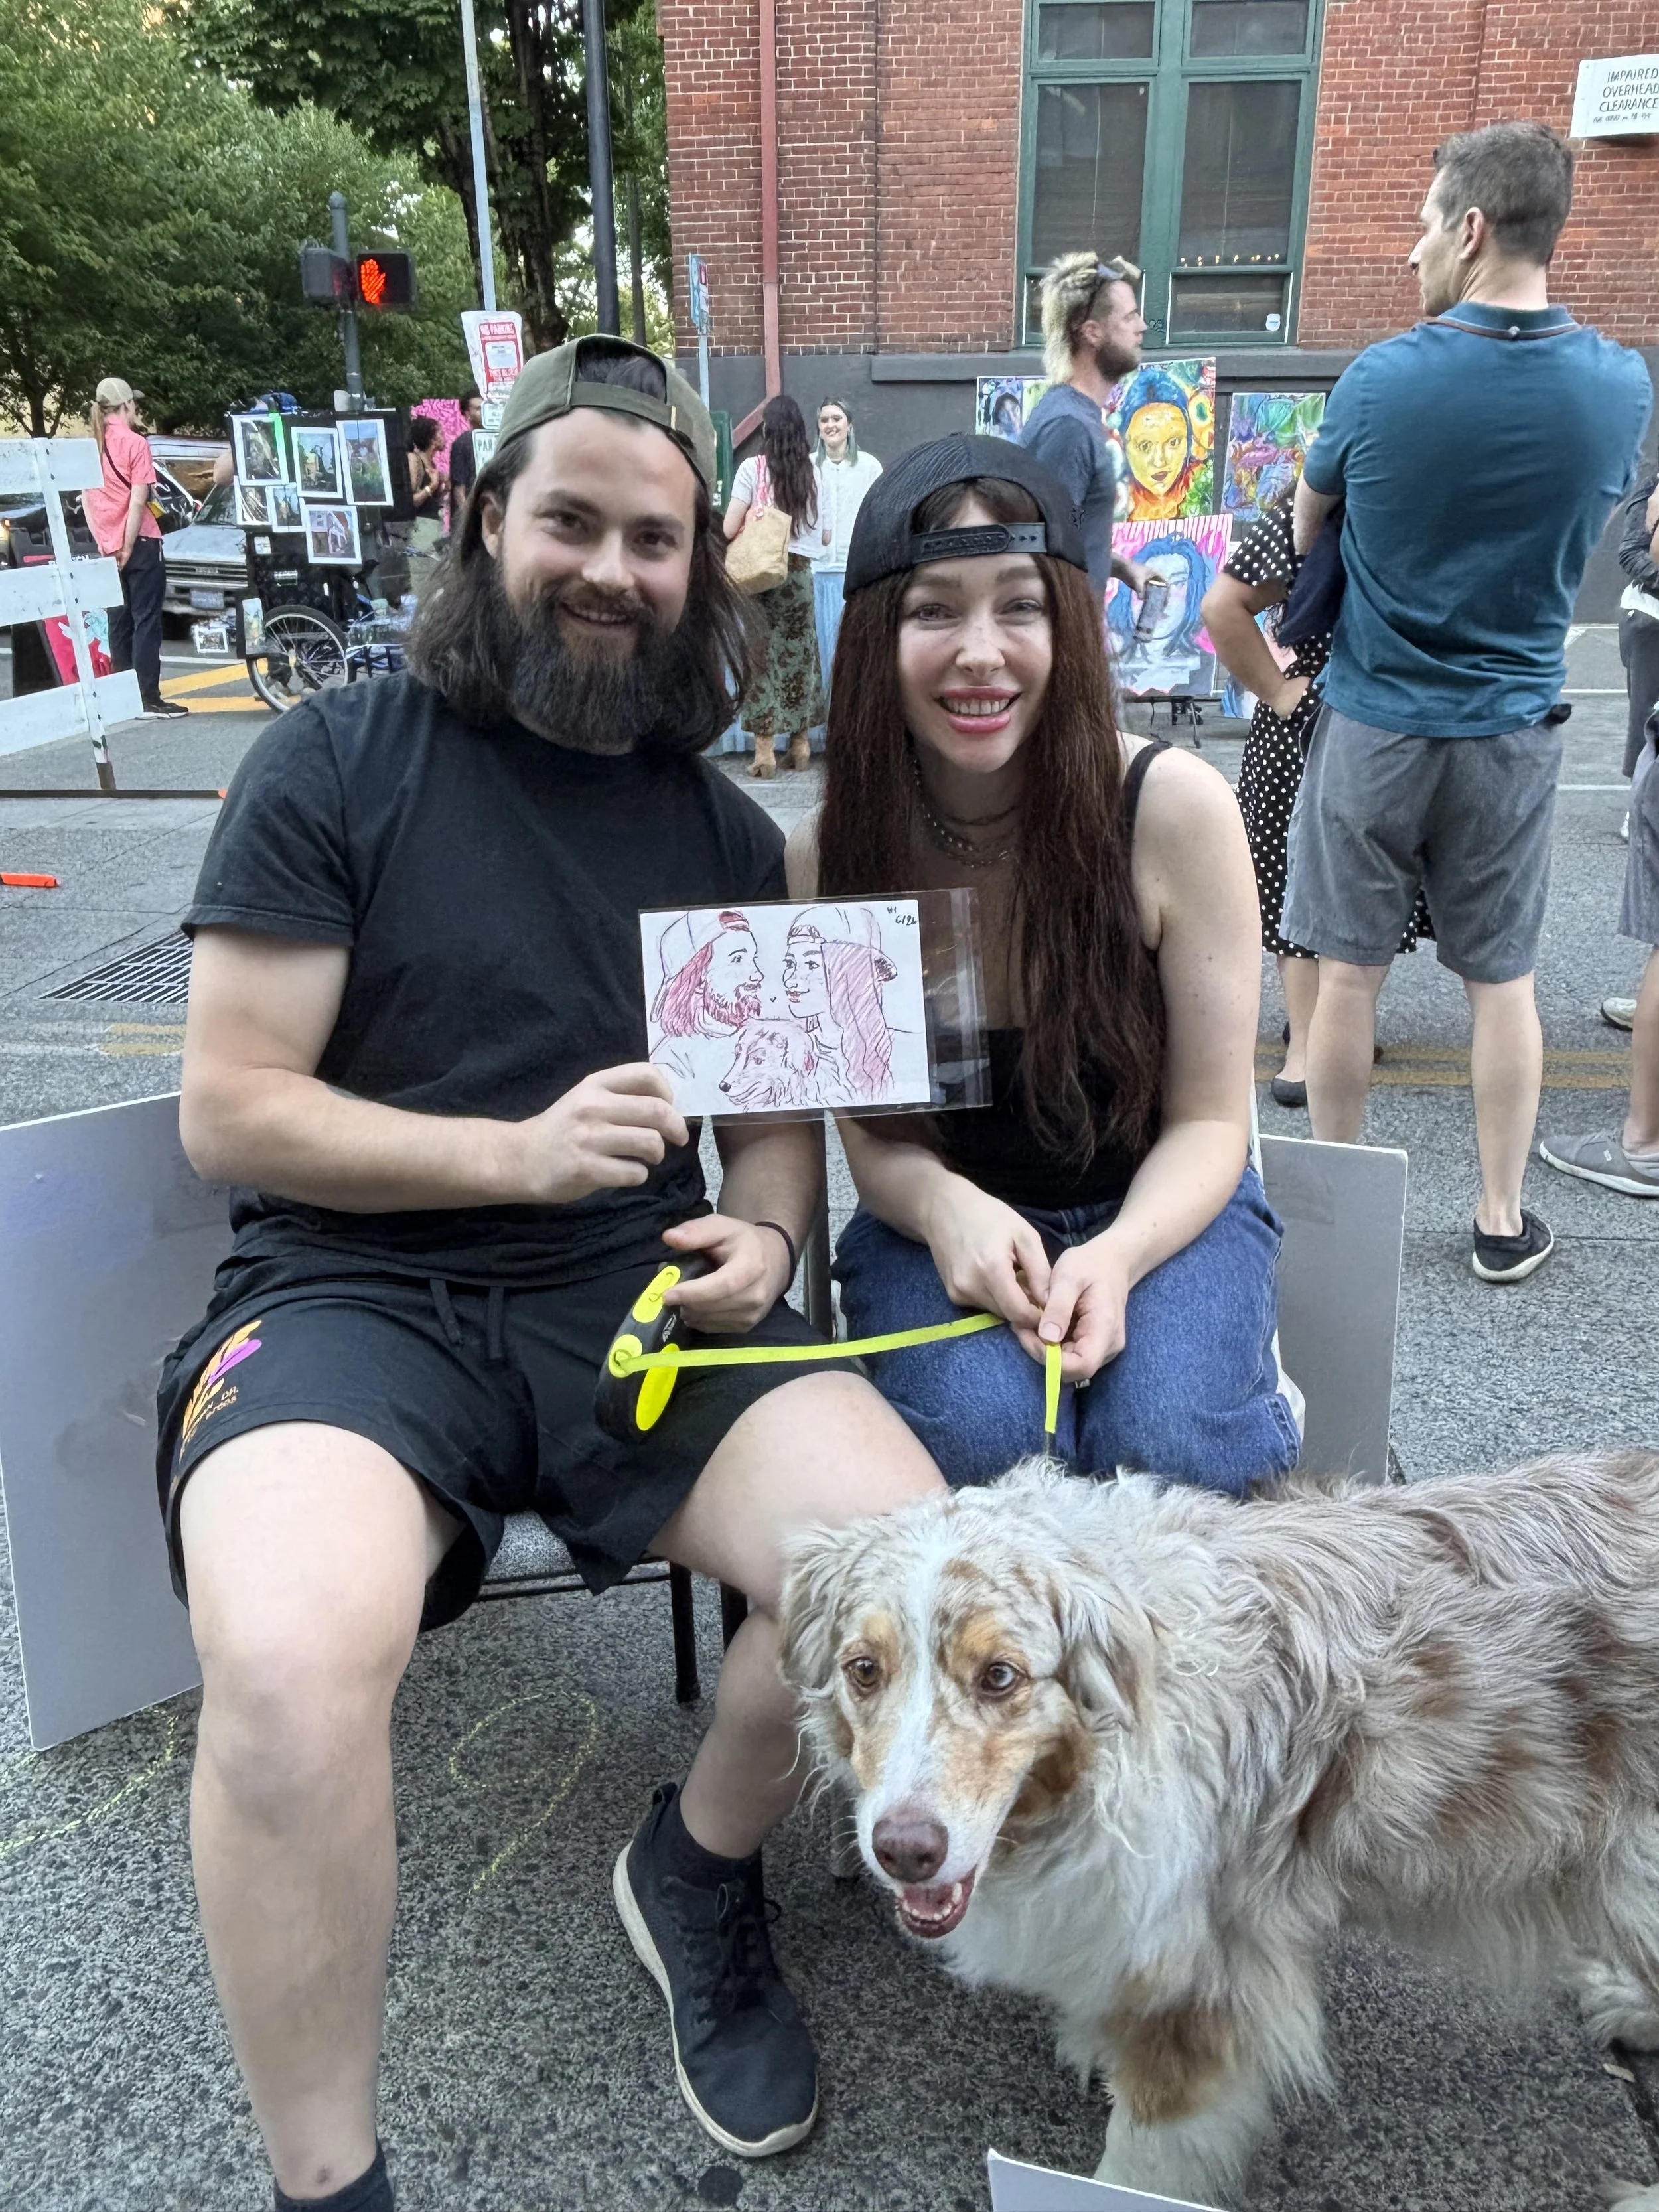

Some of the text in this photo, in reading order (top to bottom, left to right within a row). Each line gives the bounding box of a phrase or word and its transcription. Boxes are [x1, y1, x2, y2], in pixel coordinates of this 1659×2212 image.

[1607, 68, 1659, 83] IMPAIRED
[1603, 82, 1659, 98] OVERHEAD
[1599, 97, 1659, 112] CLEARANCE
